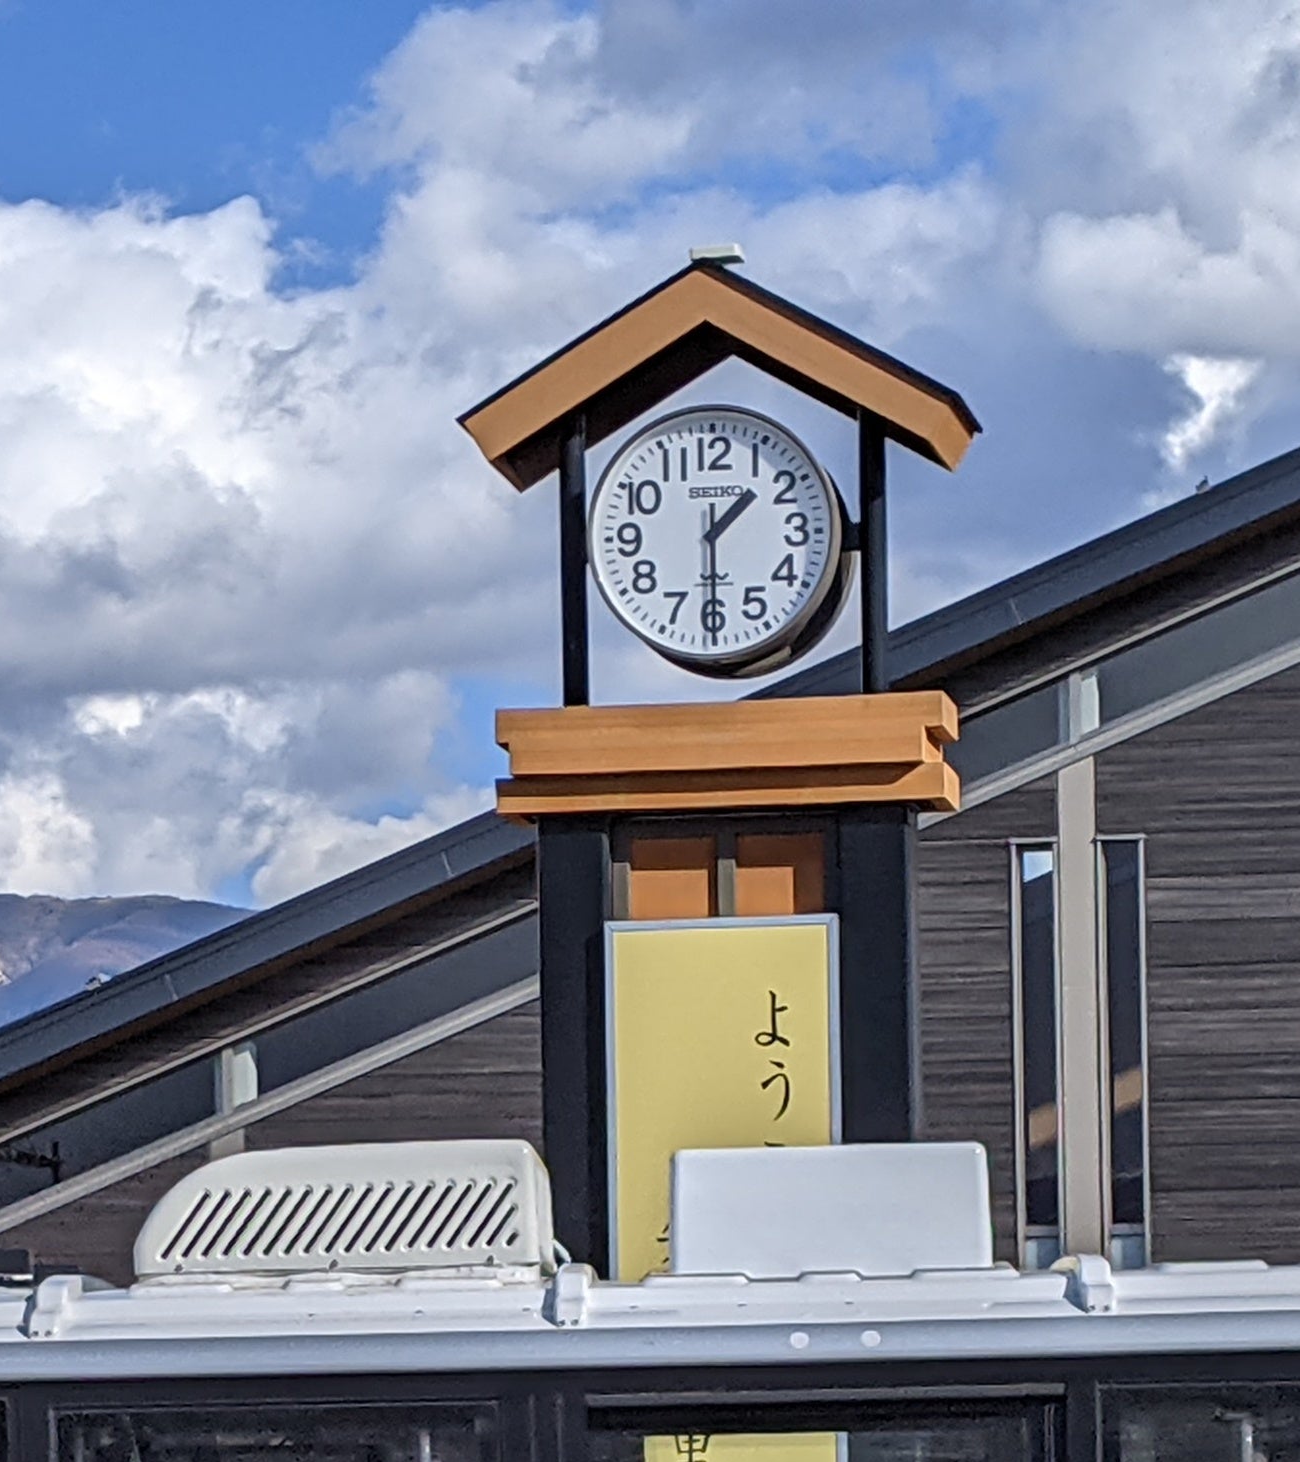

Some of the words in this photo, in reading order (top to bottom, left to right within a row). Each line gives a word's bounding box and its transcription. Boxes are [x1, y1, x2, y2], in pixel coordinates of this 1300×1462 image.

[662, 447, 688, 482] 11
[697, 436, 733, 472] 12
[628, 480, 663, 515] 10
[688, 485, 744, 499] SEIKO
[772, 470, 798, 505] 2
[616, 522, 643, 557] 9
[783, 512, 810, 547] 3
[632, 559, 658, 594] 8
[770, 553, 798, 588] 4
[662, 591, 690, 626] 7
[741, 586, 768, 621] 5
[754, 989, 791, 1148] よう
